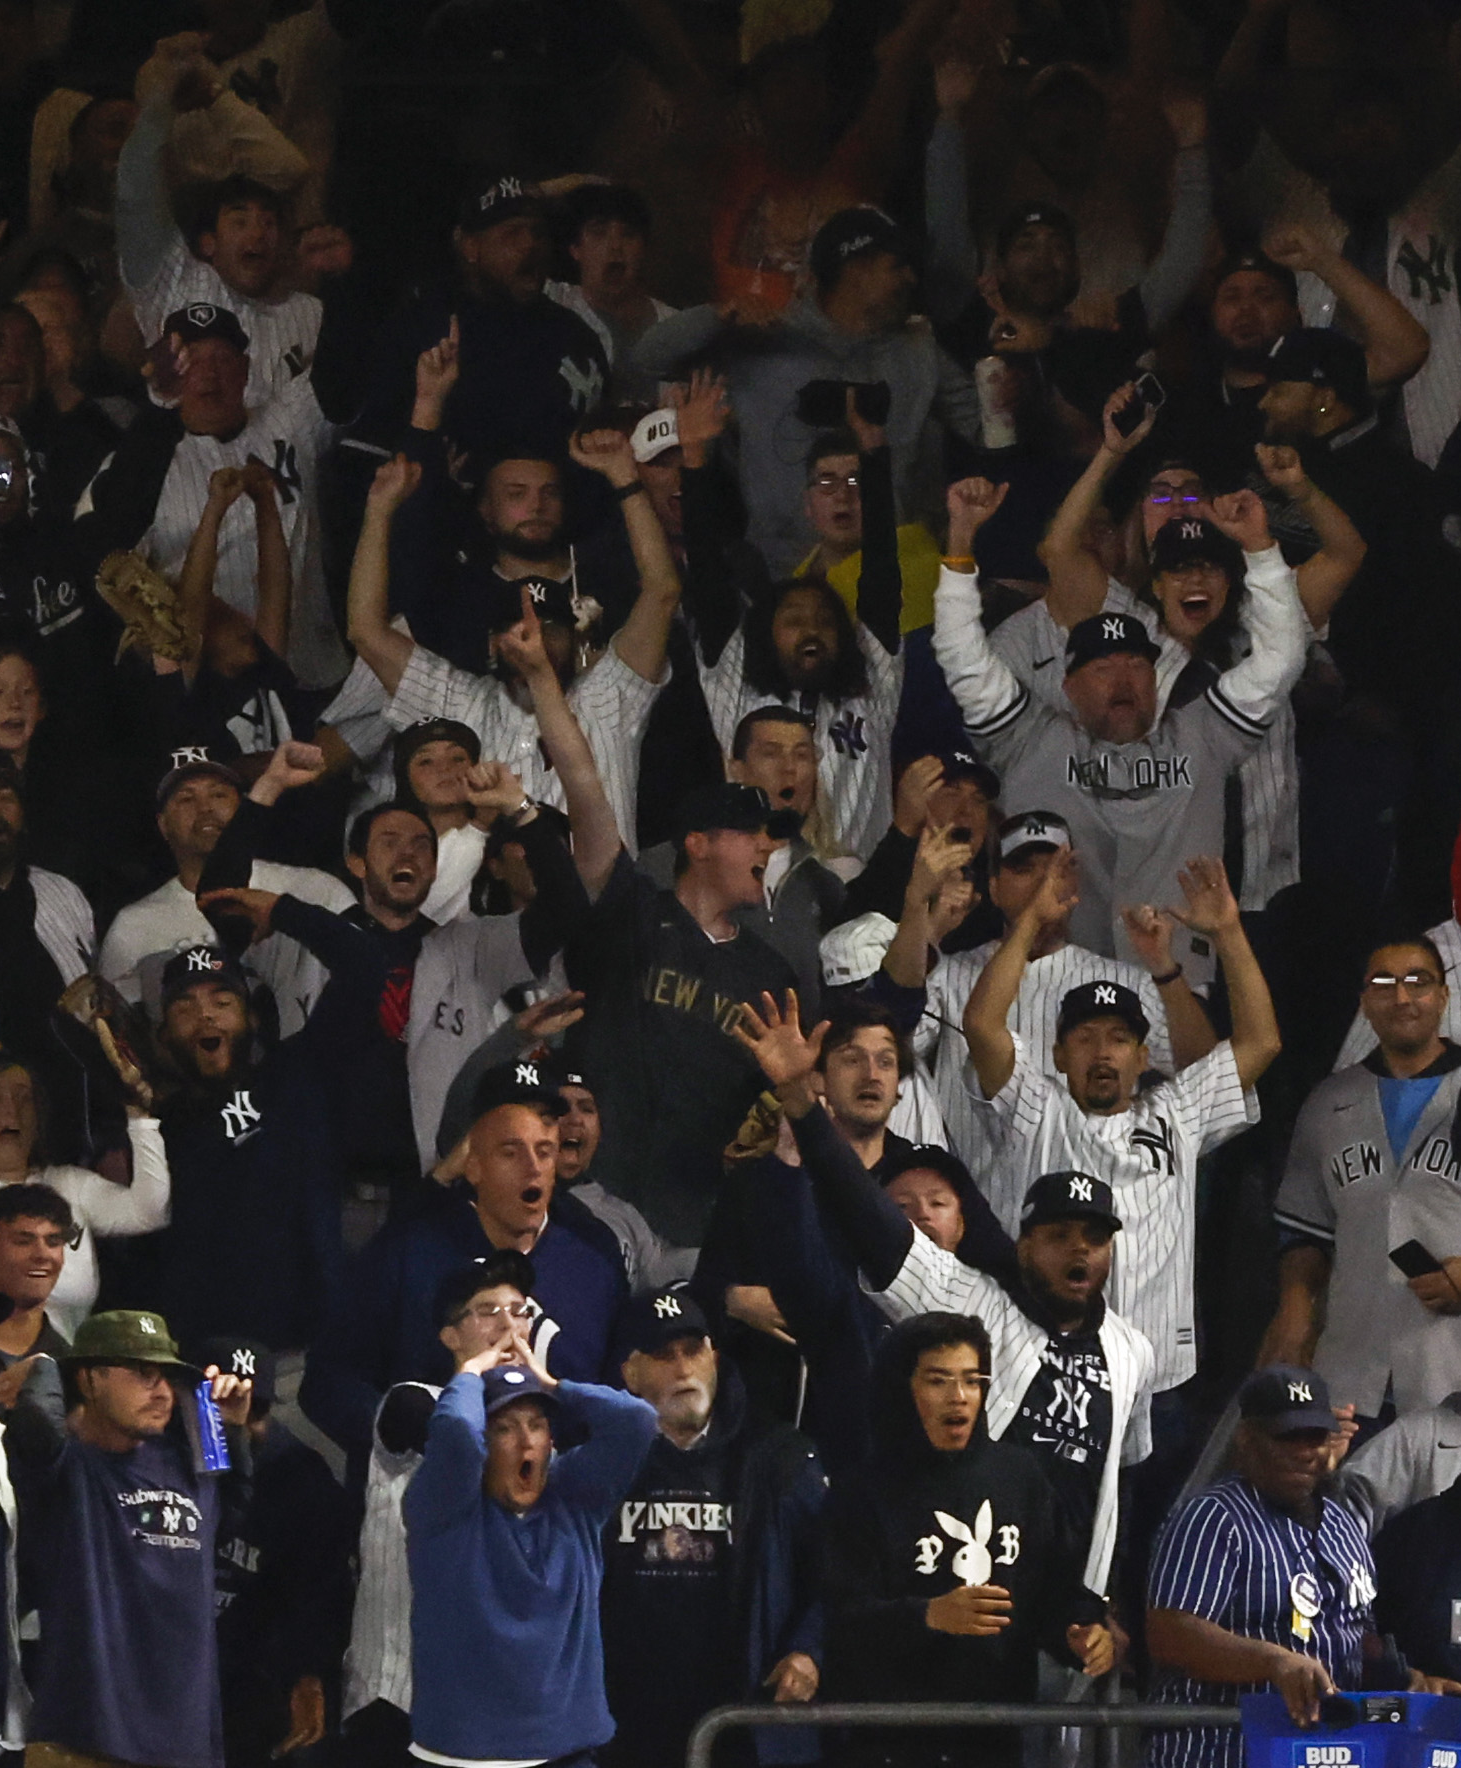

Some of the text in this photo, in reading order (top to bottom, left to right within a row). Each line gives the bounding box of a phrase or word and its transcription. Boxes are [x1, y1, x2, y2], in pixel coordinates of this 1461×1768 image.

[1397, 239, 1451, 303] NY
[528, 582, 548, 603] NY
[1103, 617, 1125, 640] NY
[832, 711, 869, 758] NY
[1116, 755, 1193, 789] ORK
[187, 950, 212, 971] NY
[1094, 984, 1118, 1006] NY
[514, 1064, 542, 1087] NY
[221, 1090, 262, 1138] NY
[1133, 1115, 1176, 1177] NY
[1331, 1142, 1383, 1189] NEW
[1068, 1176, 1094, 1202] NY
[654, 1295, 682, 1318] NY
[231, 1348, 256, 1374] NY
[1045, 1376, 1092, 1430] NY
[1289, 1383, 1313, 1403] NY
[1305, 1746, 1352, 1766] BUD
[1432, 1749, 1458, 1768] BUD
